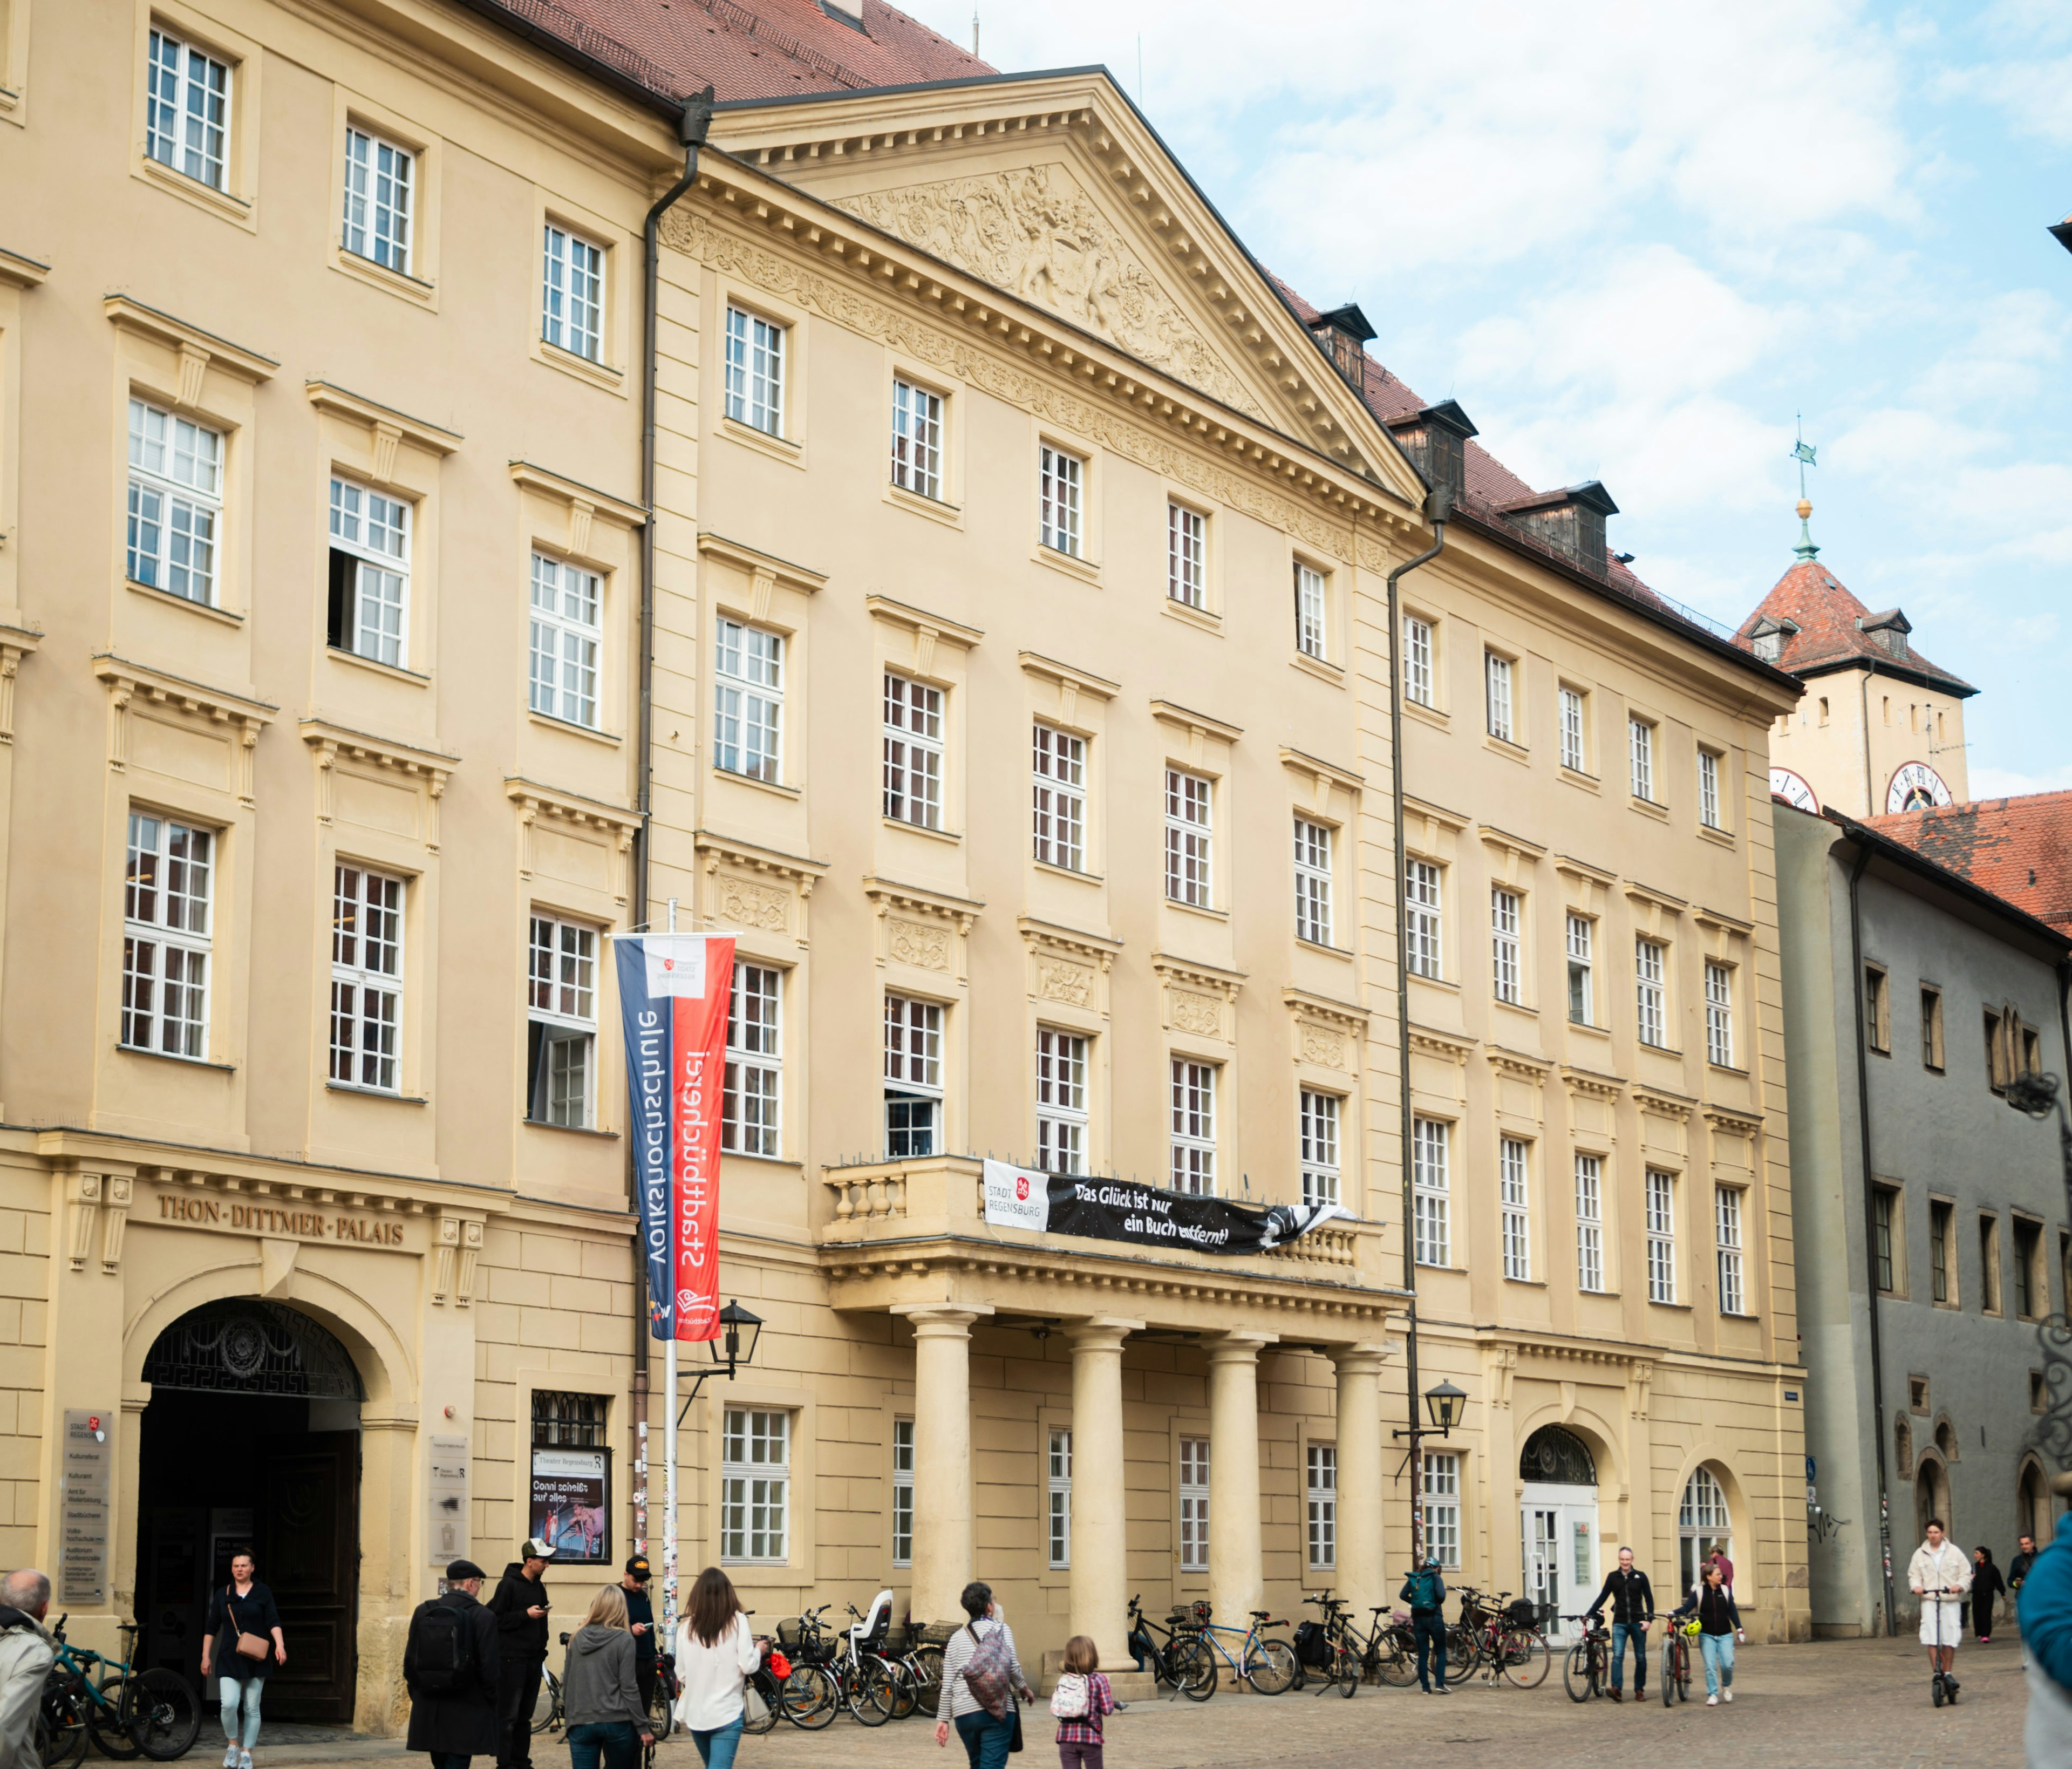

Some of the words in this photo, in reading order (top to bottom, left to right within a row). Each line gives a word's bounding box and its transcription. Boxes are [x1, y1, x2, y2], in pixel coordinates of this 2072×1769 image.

[989, 1186, 1012, 1199] STADT
[1074, 1183, 1097, 1202] Das
[1099, 1186, 1132, 1208] Glück
[1134, 1190, 1148, 1210] ist
[1151, 1199, 1173, 1214] nur
[989, 1200, 1040, 1217] REGENSBURG
[1124, 1214, 1143, 1233] ein
[1146, 1216, 1176, 1237] Buch
[1178, 1224, 1229, 1244] entfernt!
[540, 1457, 561, 1465] Theater
[562, 1457, 593, 1467] Regensburg
[533, 1480, 556, 1491] Conni
[558, 1481, 589, 1493] scheißt
[67, 1496, 101, 1504] Weiterbildung
[549, 1492, 567, 1503] alles
